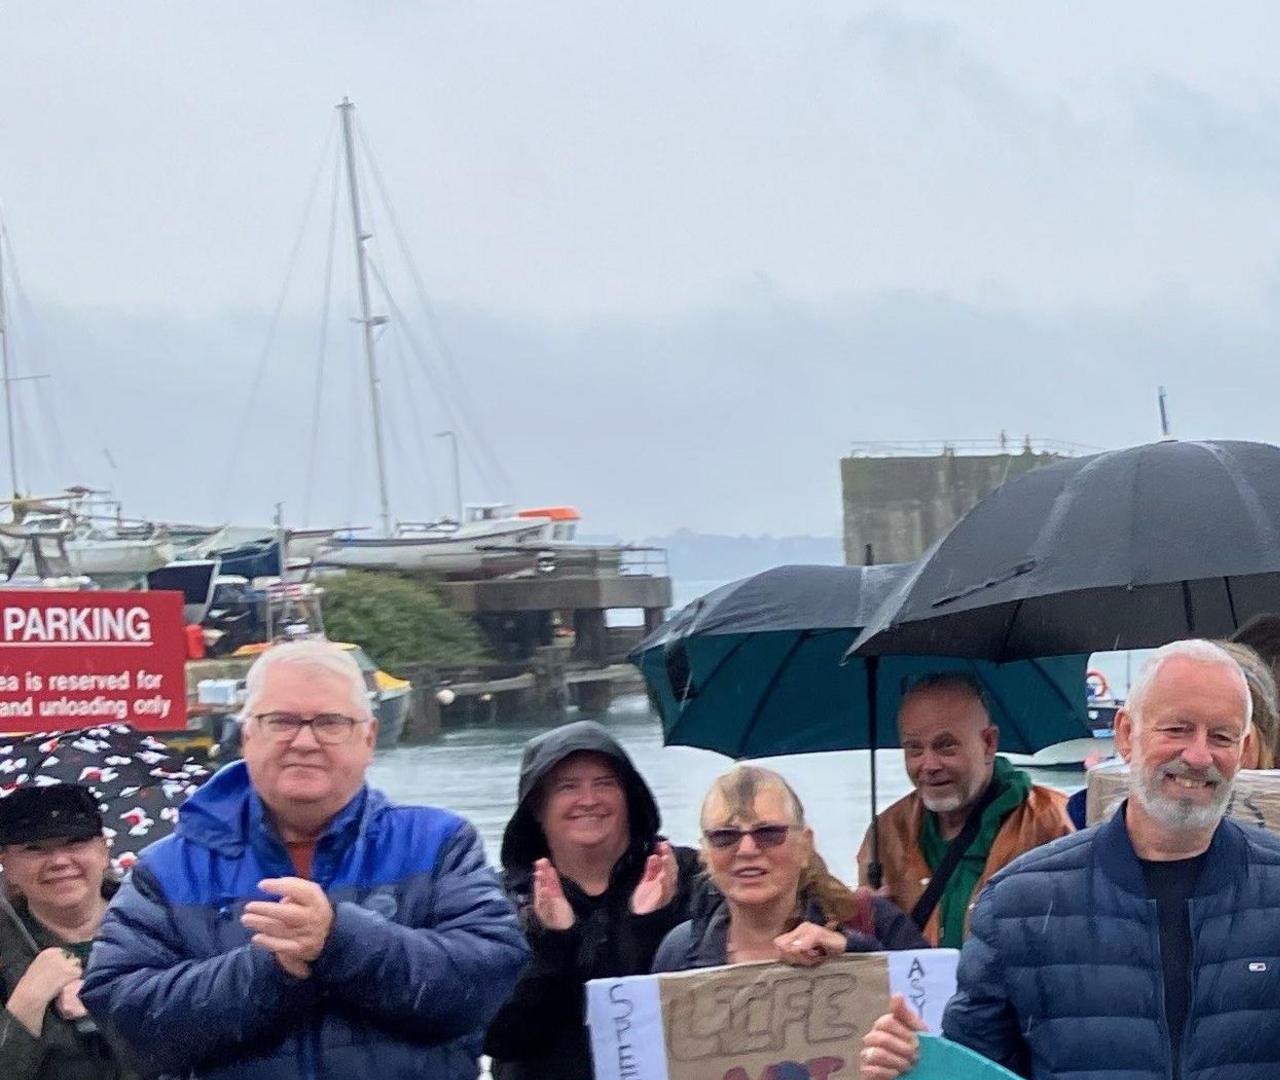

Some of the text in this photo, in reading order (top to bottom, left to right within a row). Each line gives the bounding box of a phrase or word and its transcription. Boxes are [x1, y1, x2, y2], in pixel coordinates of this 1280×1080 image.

[4, 607, 152, 641] PARKING
[25, 671, 42, 691] is
[49, 670, 130, 692] reserved
[137, 670, 163, 690] for
[0, 695, 172, 719] and unloading only
[667, 973, 858, 1062] LIFE
